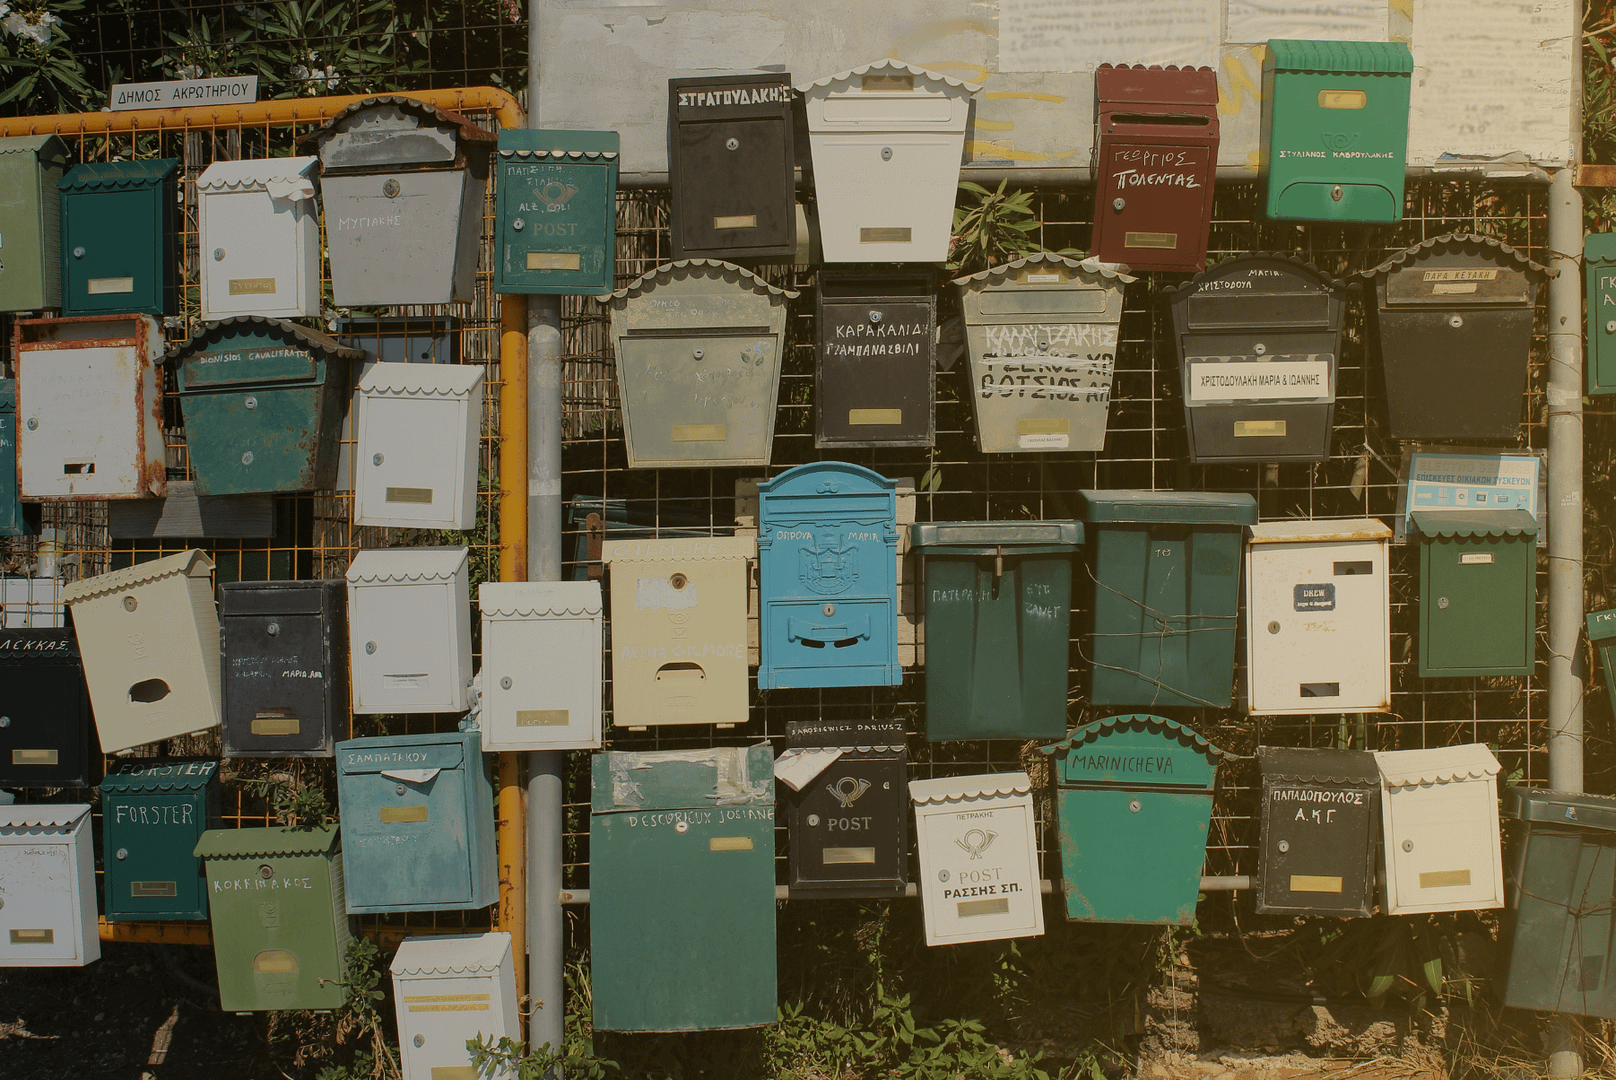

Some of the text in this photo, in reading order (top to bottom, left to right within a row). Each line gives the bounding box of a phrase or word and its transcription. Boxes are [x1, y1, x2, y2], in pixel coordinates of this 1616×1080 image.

[118, 83, 248, 104] ΔΗΜΟΣ ΑΚΡΩΤΗΡΙΟΥ
[678, 85, 792, 106] ΣΤΡΑΤΟΥΔΑΚΗΣ
[1279, 150, 1327, 158] ΣΤΥΛΙΑΝΟΣ
[1113, 169, 1201, 189] ΠΟΛΕΝΤΑΣ
[533, 223, 578, 236] POST
[1200, 374, 1320, 387] ΧΡΙΣΤΟΔΟΥΛΑΚΗ ΜΑΡΙΑ & ΙΩΑΝΝΗΣ
[1416, 474, 1531, 486] ΕΠΙΣΚΕΥΕΣ ΟΙΚΙΑΚΩΝ ΣΥΣΚΕΥΩΝ
[613, 543, 718, 557] GILMORE
[1303, 589, 1325, 597] DREW
[673, 643, 744, 659] GILMORE
[857, 723, 903, 731] DARIUSZ
[116, 760, 216, 776] FORSTER
[1072, 755, 1174, 774] MARINICHEVA
[1273, 789, 1364, 805] ΠΑΠΑΔΟΠΟΥΛΟΣ
[116, 804, 193, 825] FORSTER
[956, 811, 994, 821] ΠΕΤΡΑΚΗΣ
[827, 816, 872, 831] POST
[959, 867, 1002, 885] POST
[944, 883, 1023, 899] ΡΑΣΣΗΣ ΣΠ.
